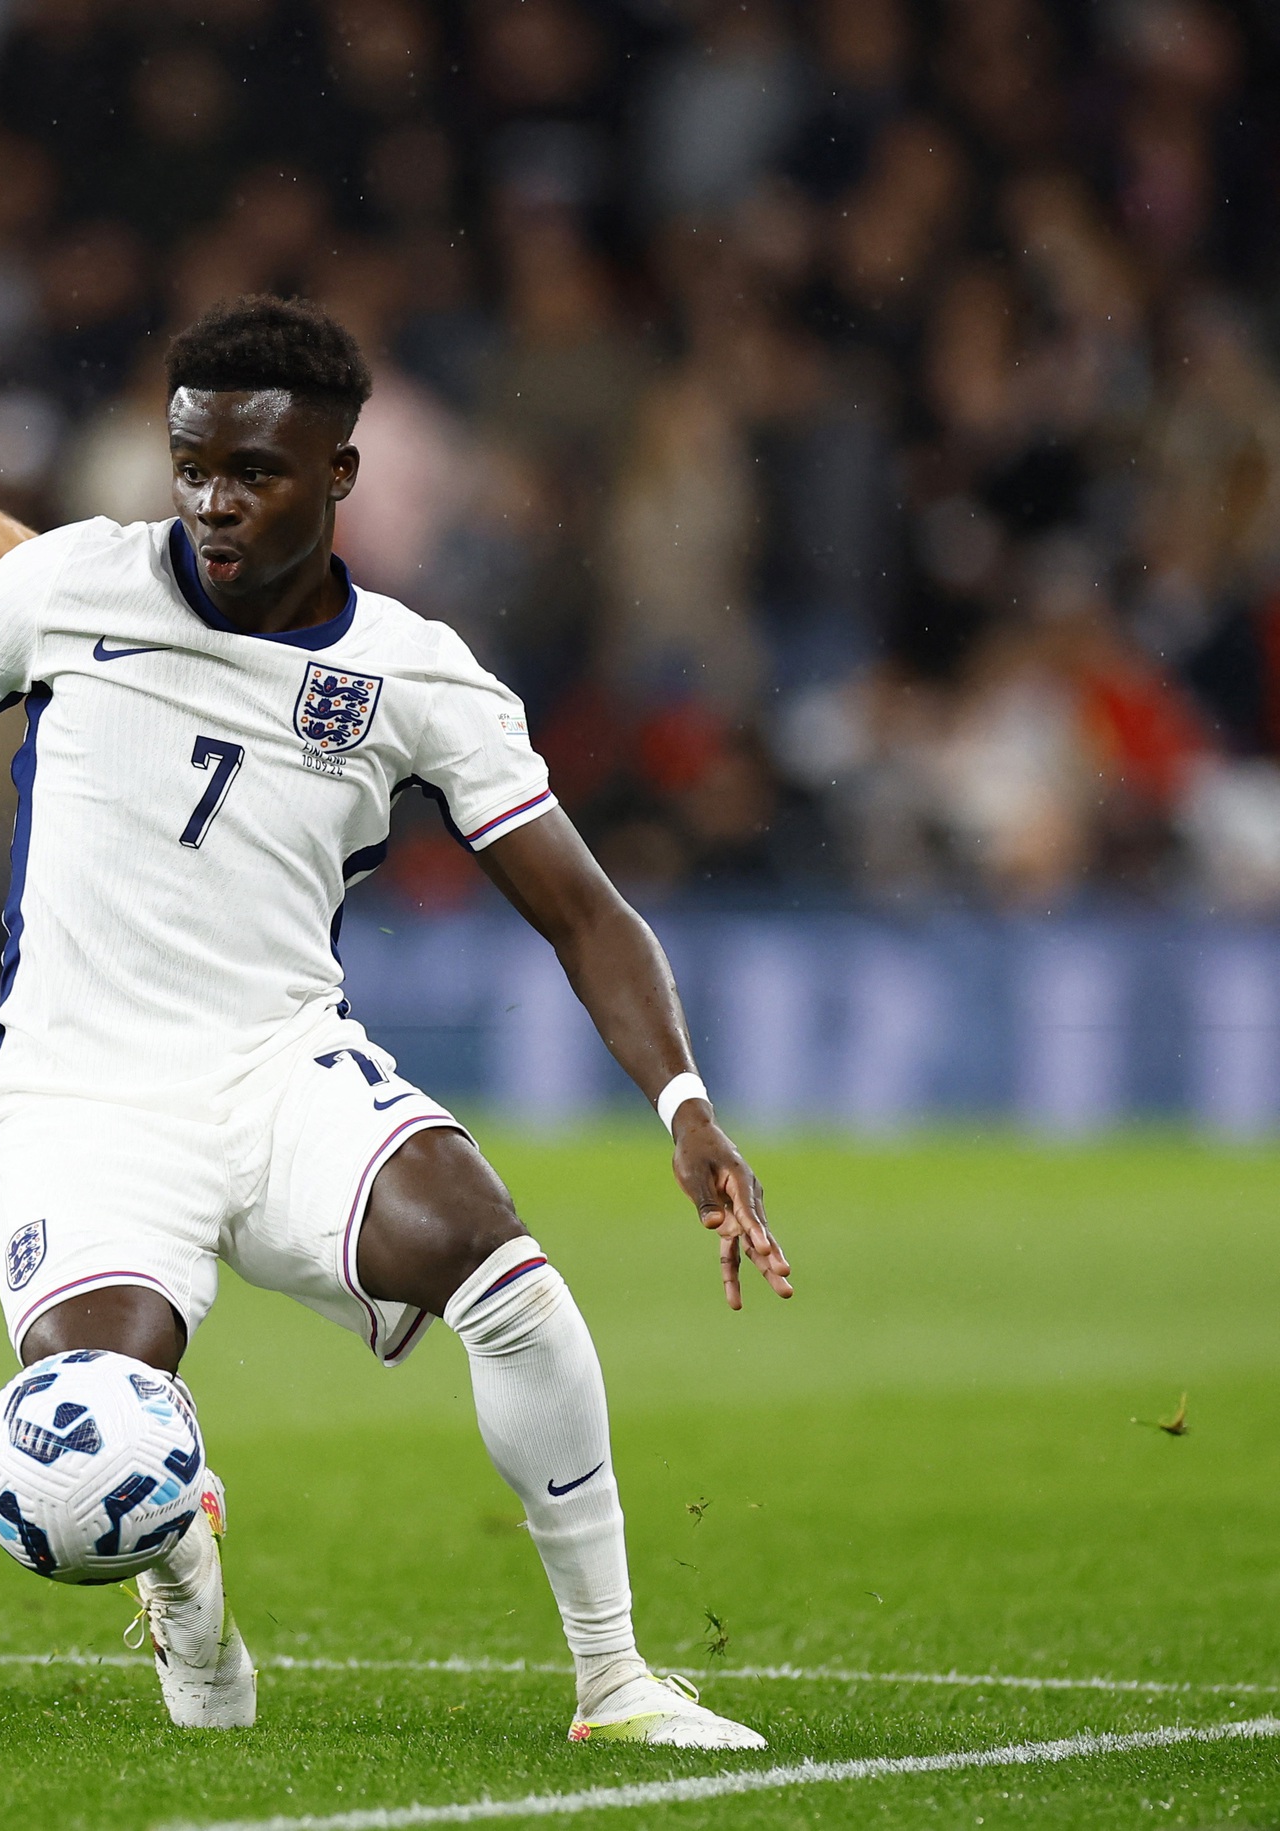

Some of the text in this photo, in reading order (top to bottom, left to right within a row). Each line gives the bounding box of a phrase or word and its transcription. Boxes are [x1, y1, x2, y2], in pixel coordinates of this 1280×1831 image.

[501, 721, 526, 731] FOUN
[302, 754, 344, 777] 10.09.24
[179, 735, 246, 850] 7
[313, 1048, 390, 1087] 7
